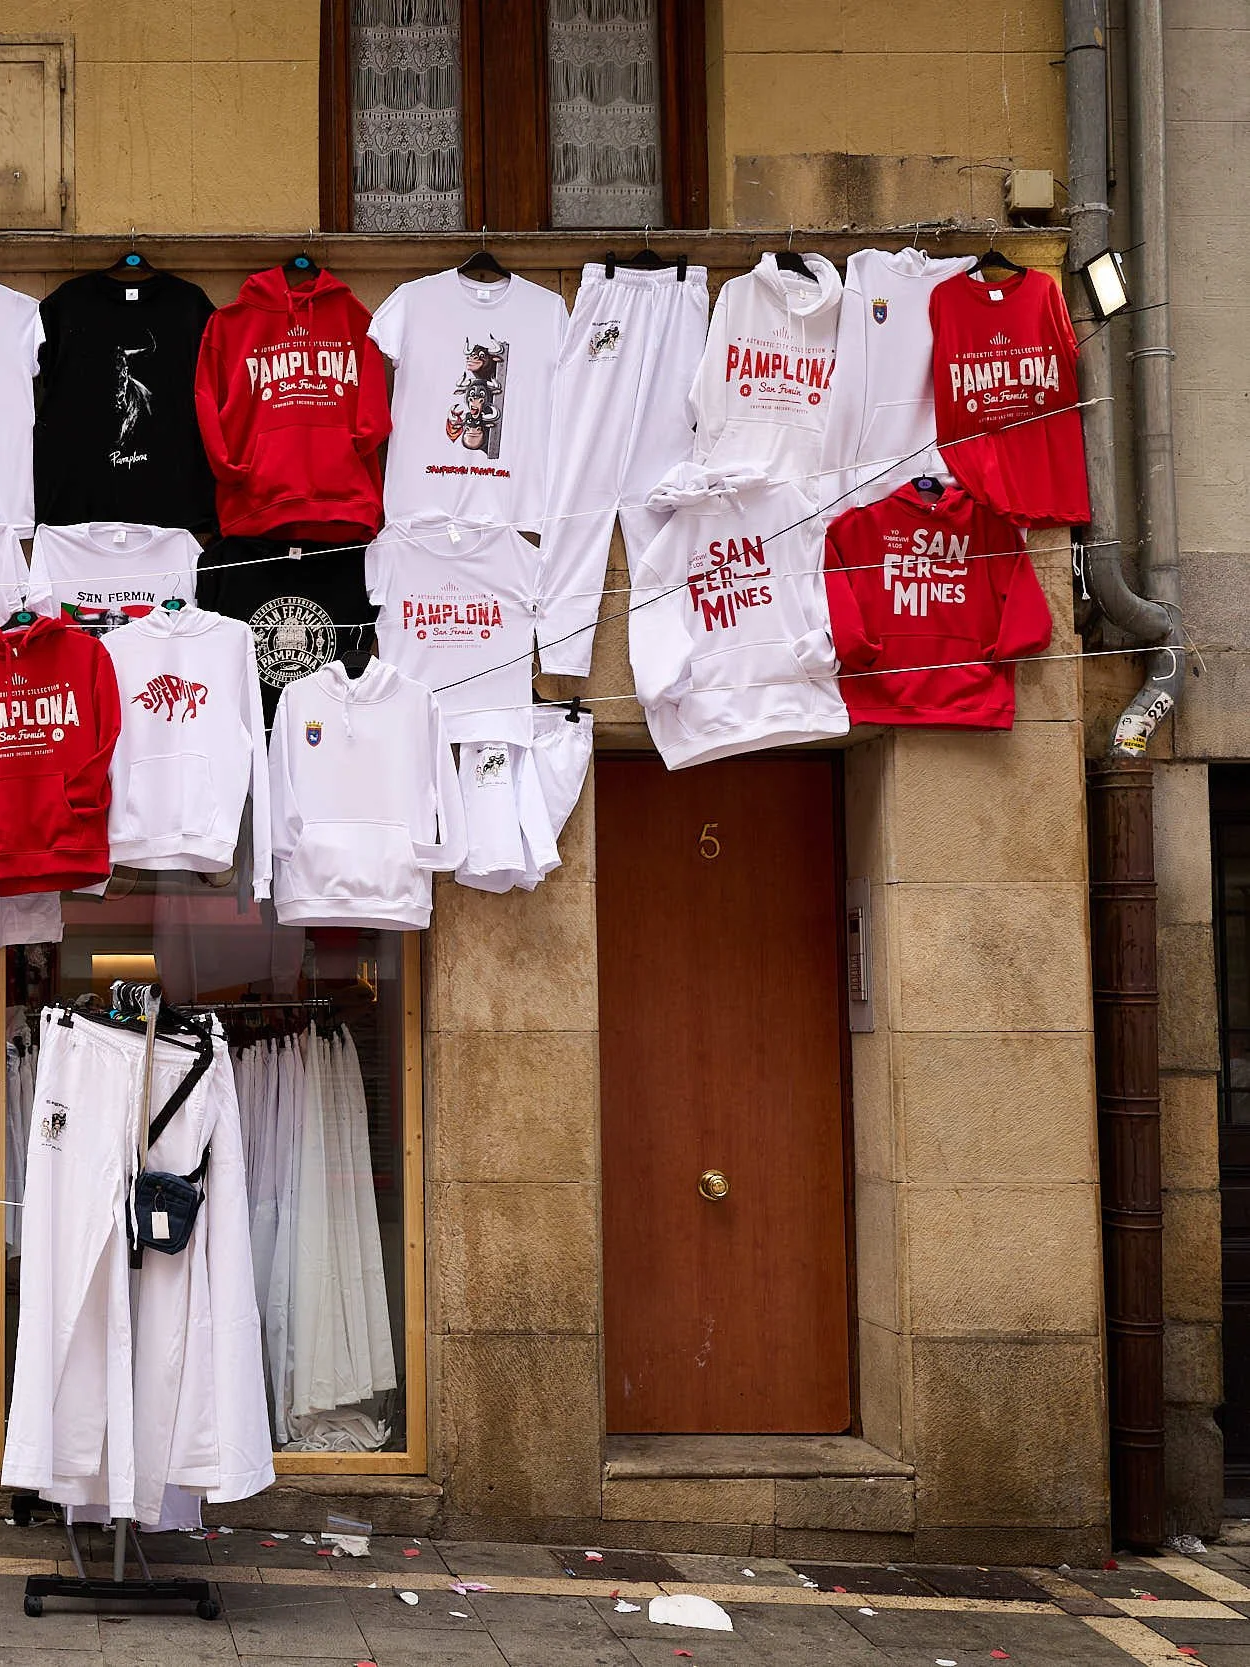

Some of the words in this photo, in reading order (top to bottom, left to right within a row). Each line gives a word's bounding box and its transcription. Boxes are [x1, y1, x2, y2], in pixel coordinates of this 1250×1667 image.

[245, 349, 359, 396] PAMPLONA
[278, 380, 297, 392] San
[758, 381, 776, 393] San
[949, 354, 1060, 402] PAMPLONA
[708, 535, 766, 568] SAN
[911, 528, 970, 565] SAN
[686, 566, 734, 612] FER
[883, 553, 932, 591] FER
[76, 591, 103, 603] SAN
[108, 591, 156, 603] FERMIN
[402, 600, 504, 629] PAMPLONA
[700, 585, 773, 632] MINES
[893, 580, 967, 617] MINES
[260, 650, 318, 670] PAMPLONA
[27, 683, 60, 696] COLLECTION
[699, 823, 720, 859] 5
